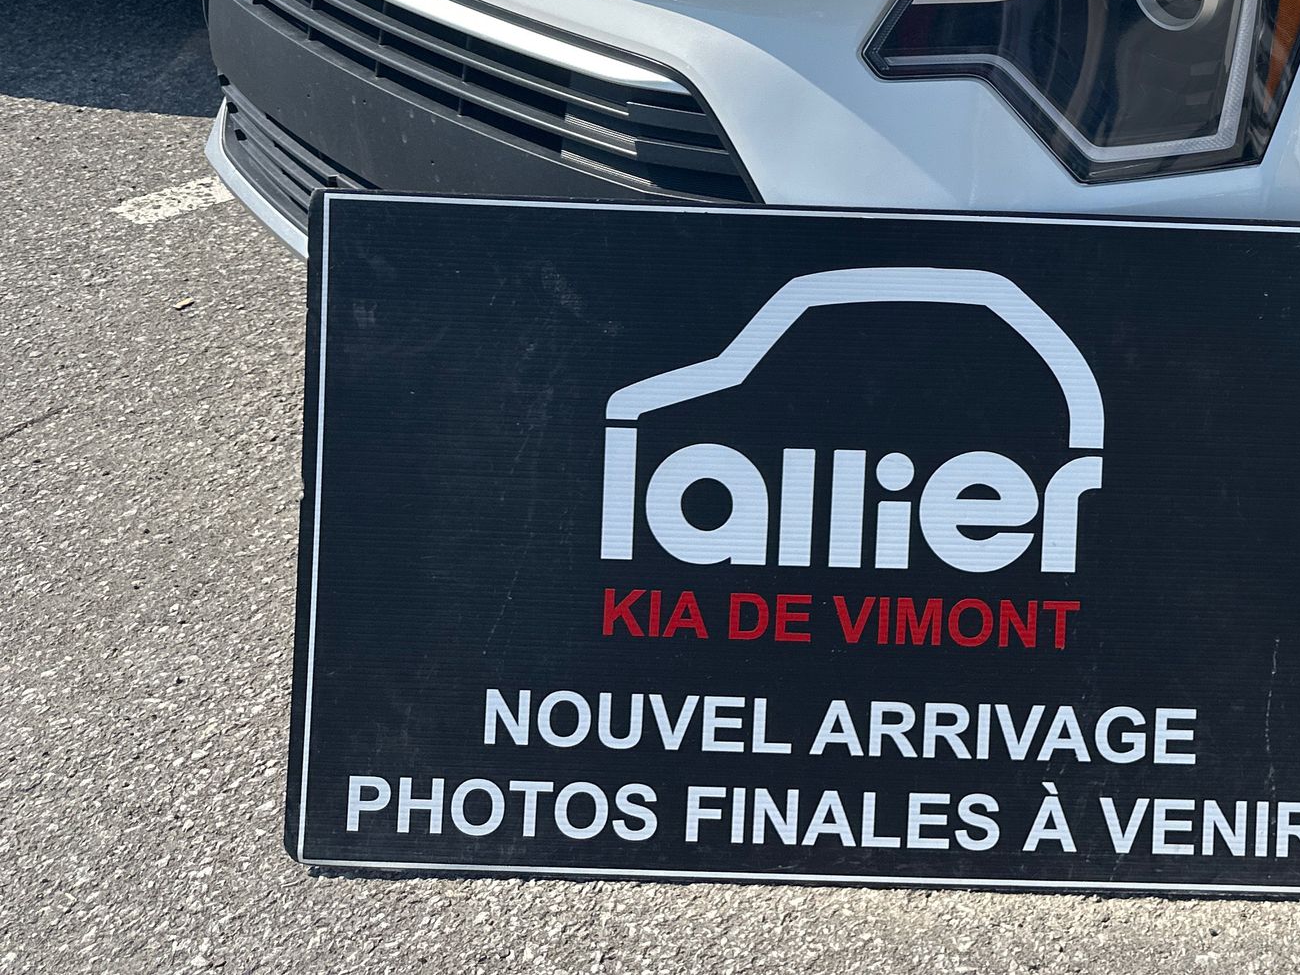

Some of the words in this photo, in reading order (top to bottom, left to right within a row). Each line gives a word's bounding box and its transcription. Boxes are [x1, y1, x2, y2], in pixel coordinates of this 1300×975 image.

[602, 588, 708, 639] KIA
[728, 592, 812, 642] DE
[833, 595, 1081, 649] VIMONT
[484, 688, 792, 755] NOUVEL
[810, 699, 1198, 765] ARRIVAGE
[346, 775, 658, 842] PHOTOS
[685, 785, 1001, 852] FINALES
[1022, 781, 1077, 853] À
